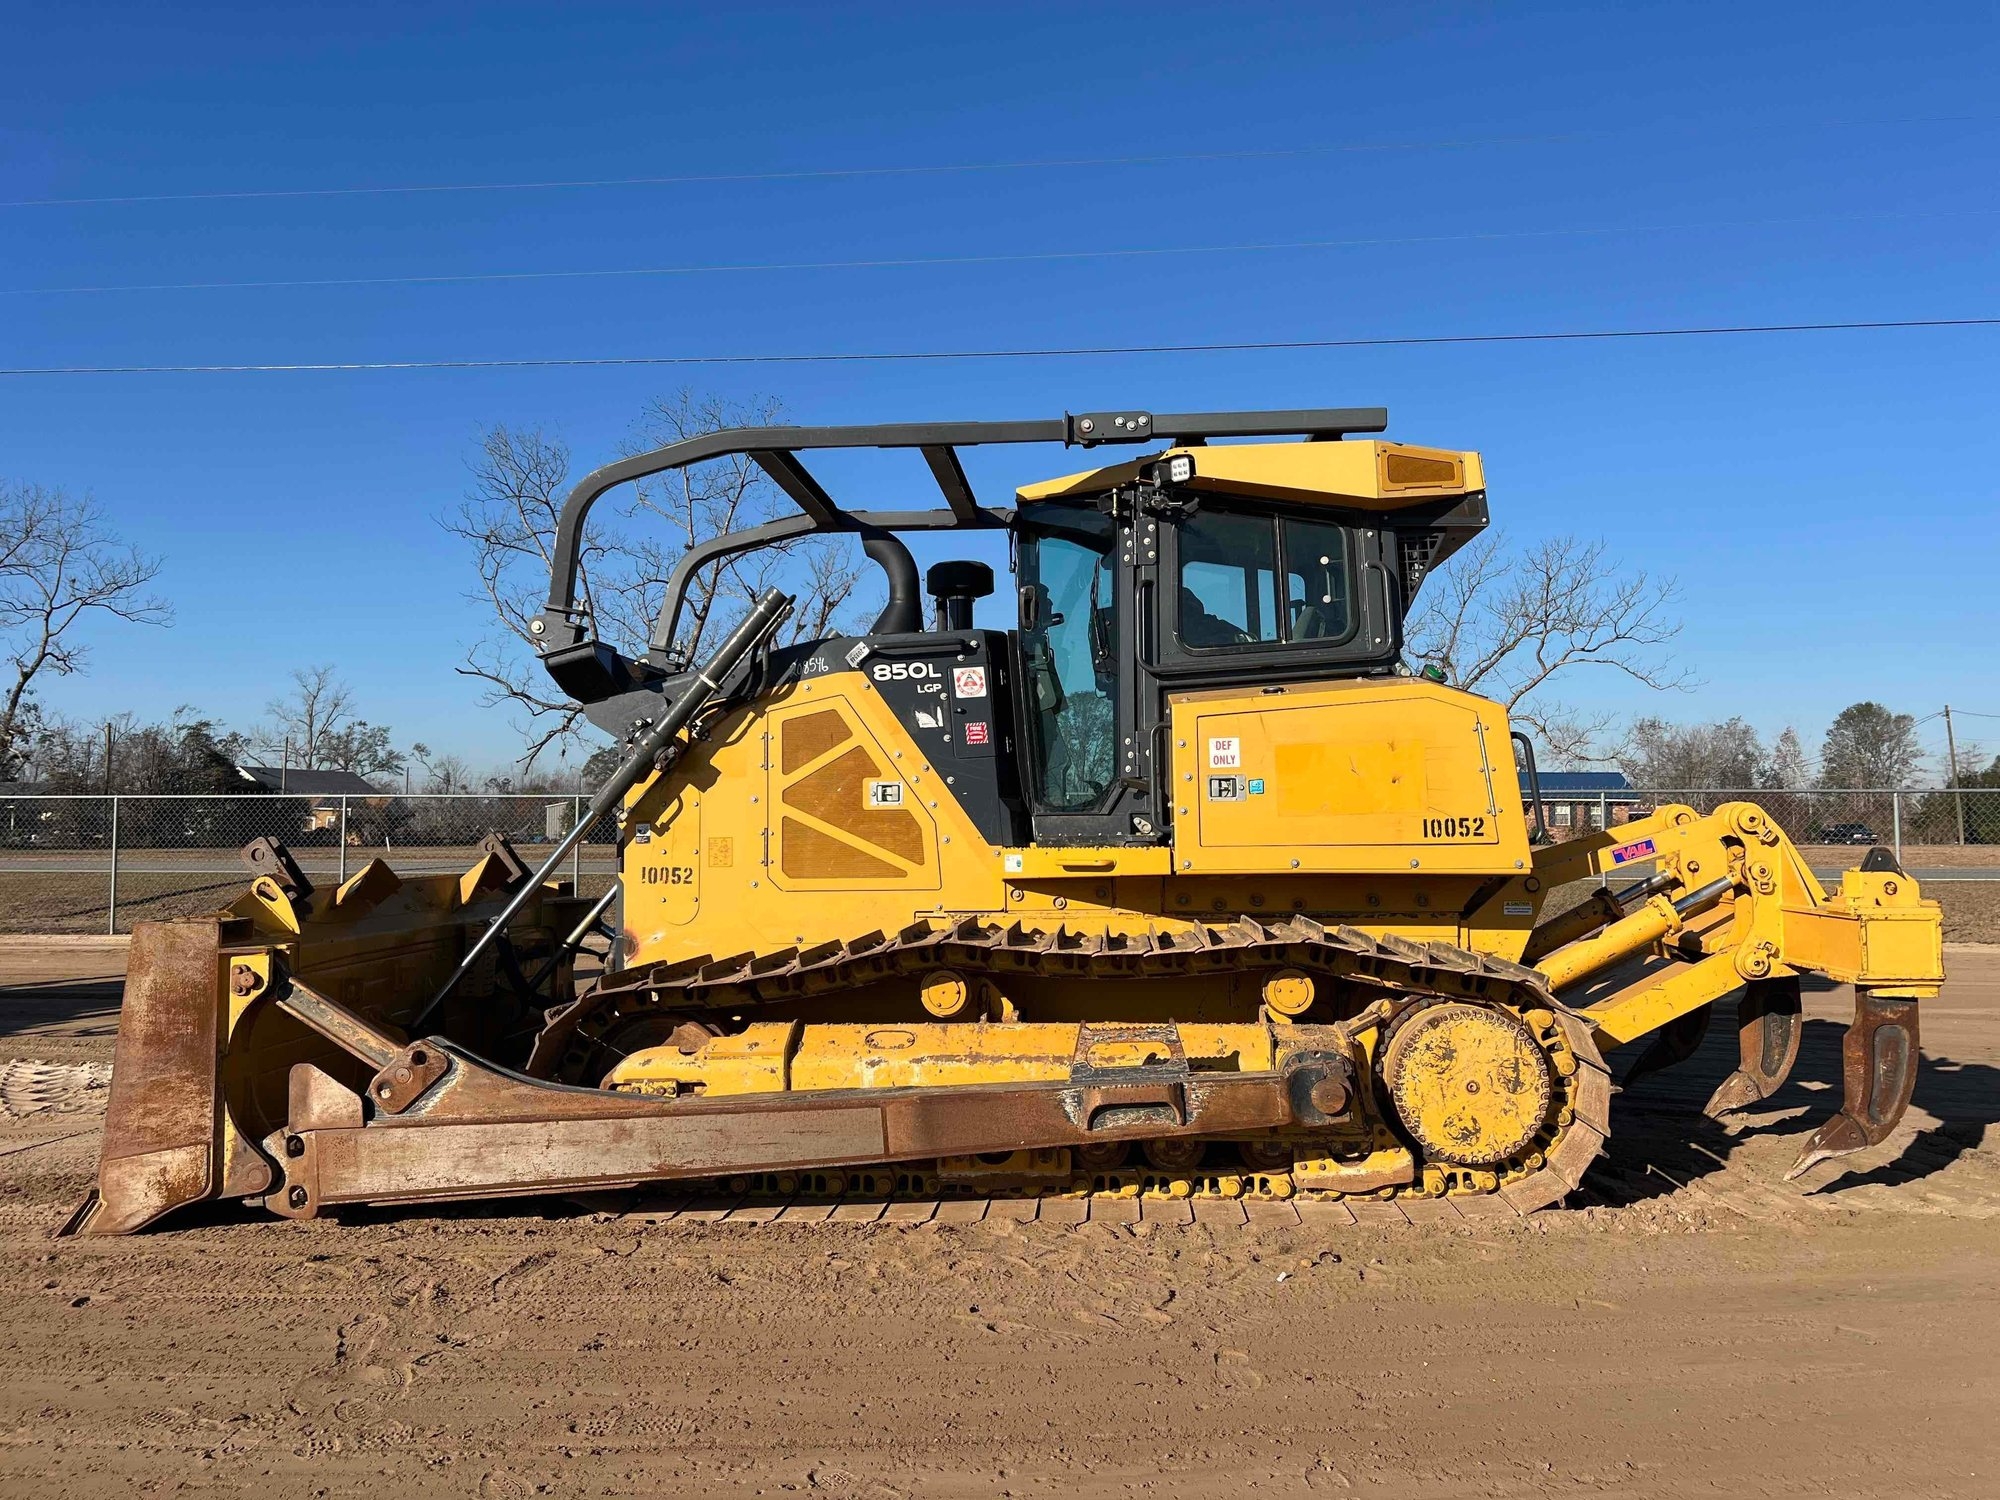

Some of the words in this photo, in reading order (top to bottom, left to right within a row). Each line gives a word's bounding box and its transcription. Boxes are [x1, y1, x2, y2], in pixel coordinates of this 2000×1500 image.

[873, 662, 942, 681] 850L
[917, 683, 942, 694] LGP
[1215, 740, 1232, 751] DEF
[1213, 755, 1236, 765] ONLY
[1423, 817, 1485, 838] 10052
[1613, 842, 1653, 860] VAIL
[641, 866, 693, 884] 10052
